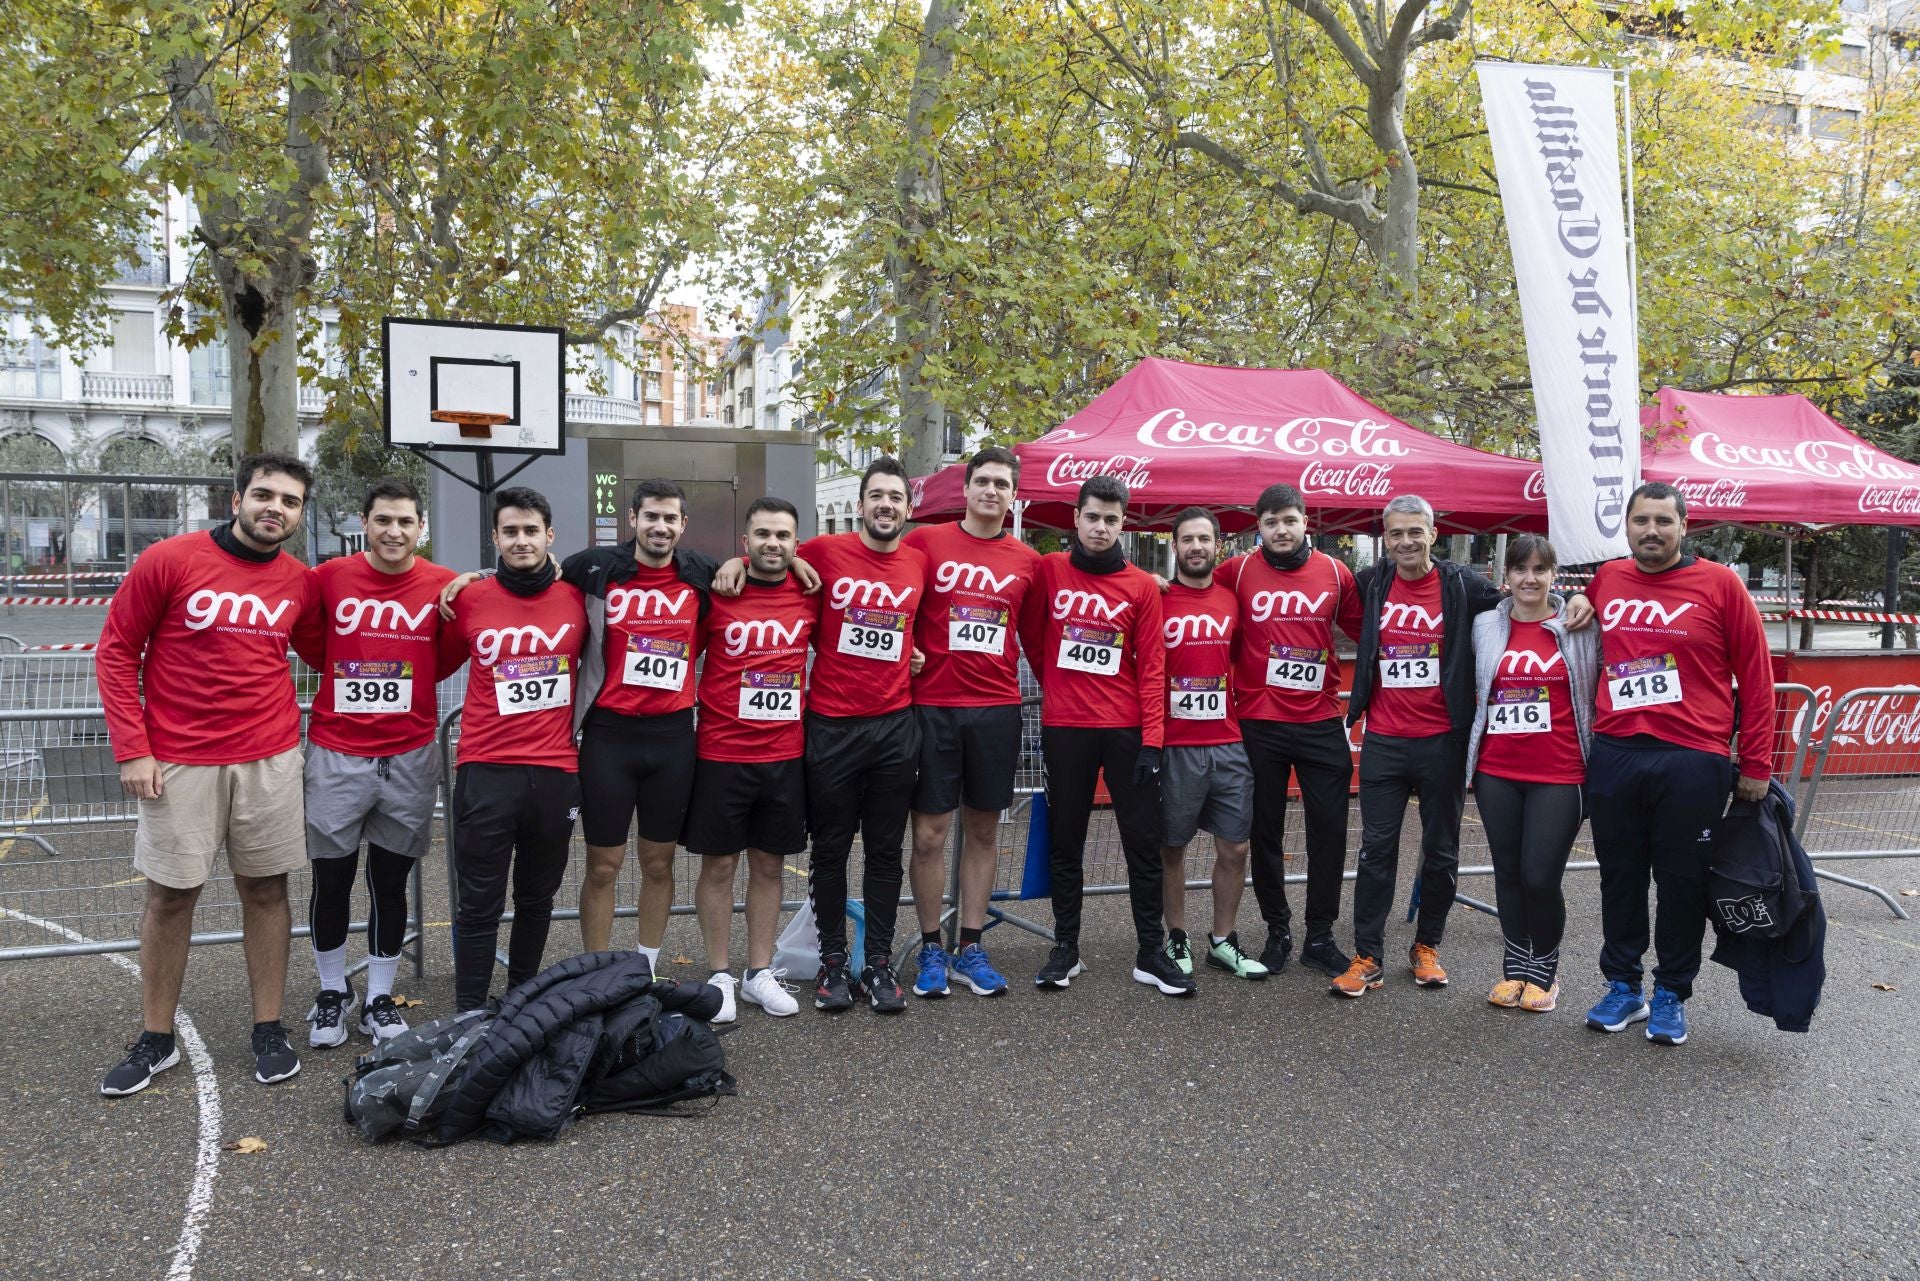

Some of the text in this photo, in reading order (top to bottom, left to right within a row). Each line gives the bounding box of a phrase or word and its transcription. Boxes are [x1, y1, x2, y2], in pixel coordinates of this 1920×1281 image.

[1137, 408, 1409, 456] Coca-Cola
[1047, 452, 1154, 489] Coca-Cola
[1690, 432, 1916, 481] Coca-Cola
[596, 474, 617, 485] WC
[1300, 461, 1395, 496] Coca-Cola
[1858, 484, 1920, 513] Coca-Col
[934, 560, 1017, 593] gmv
[605, 588, 690, 624] gmv
[830, 577, 913, 610] gmv
[1053, 589, 1129, 620] gmv
[1251, 590, 1329, 622] gmv
[185, 589, 290, 630] gmv
[335, 597, 434, 635] gmv
[1602, 598, 1693, 632] gmv
[216, 626, 257, 635] INNOVATING
[360, 631, 399, 639] INNOVATING
[477, 623, 570, 666] gmv
[725, 619, 804, 656] gmv
[849, 627, 893, 651] 399
[957, 623, 998, 644] 407
[1163, 614, 1231, 648] gmv
[1655, 628, 1688, 636] SOLUTIONS
[634, 656, 679, 680] 401
[1067, 644, 1110, 666] 409
[1387, 661, 1430, 678] 413
[1494, 649, 1562, 678] mv
[1275, 662, 1317, 682] 420
[1619, 674, 1668, 698] 418
[345, 682, 399, 702] 398
[507, 678, 558, 703] 397
[748, 691, 792, 711] 402
[1179, 693, 1218, 710] 410
[1495, 705, 1539, 724] 416
[1792, 684, 1920, 747] Coa-Col
